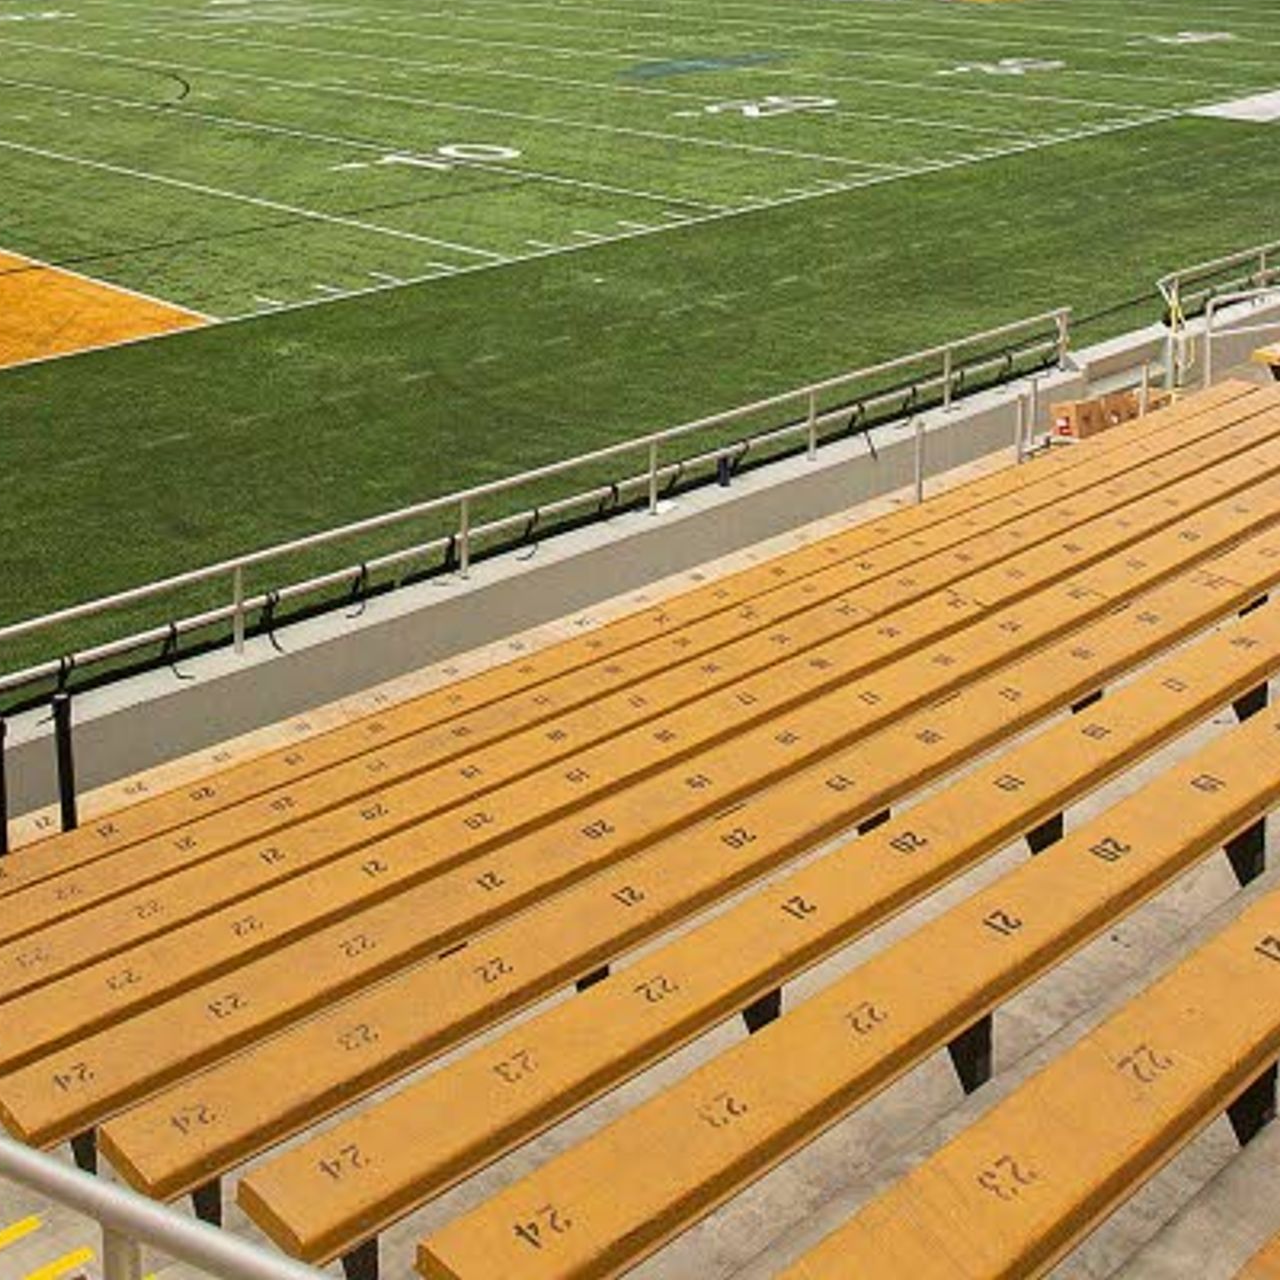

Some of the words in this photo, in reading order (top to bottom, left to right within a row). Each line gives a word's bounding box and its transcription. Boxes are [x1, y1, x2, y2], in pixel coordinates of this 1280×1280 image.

[376, 144, 521, 170] 10
[463, 813, 493, 830] 20
[581, 820, 614, 839] 20
[720, 828, 757, 849] 20
[890, 832, 928, 854] 20
[1089, 837, 1131, 862] 20
[260, 848, 285, 864] 21
[362, 860, 387, 877] 21
[476, 871, 504, 891] 21
[611, 886, 644, 907] 21
[781, 896, 817, 919] 21
[231, 916, 263, 936] 22
[983, 910, 1022, 935] 21
[339, 935, 376, 957] 22
[474, 957, 513, 983] 22
[634, 976, 679, 1002] 22
[845, 1002, 887, 1034] 22
[1117, 1043, 1174, 1083] 22
[700, 1092, 747, 1128] 23
[977, 1155, 1037, 1200] 23
[514, 1204, 571, 1248] 24
